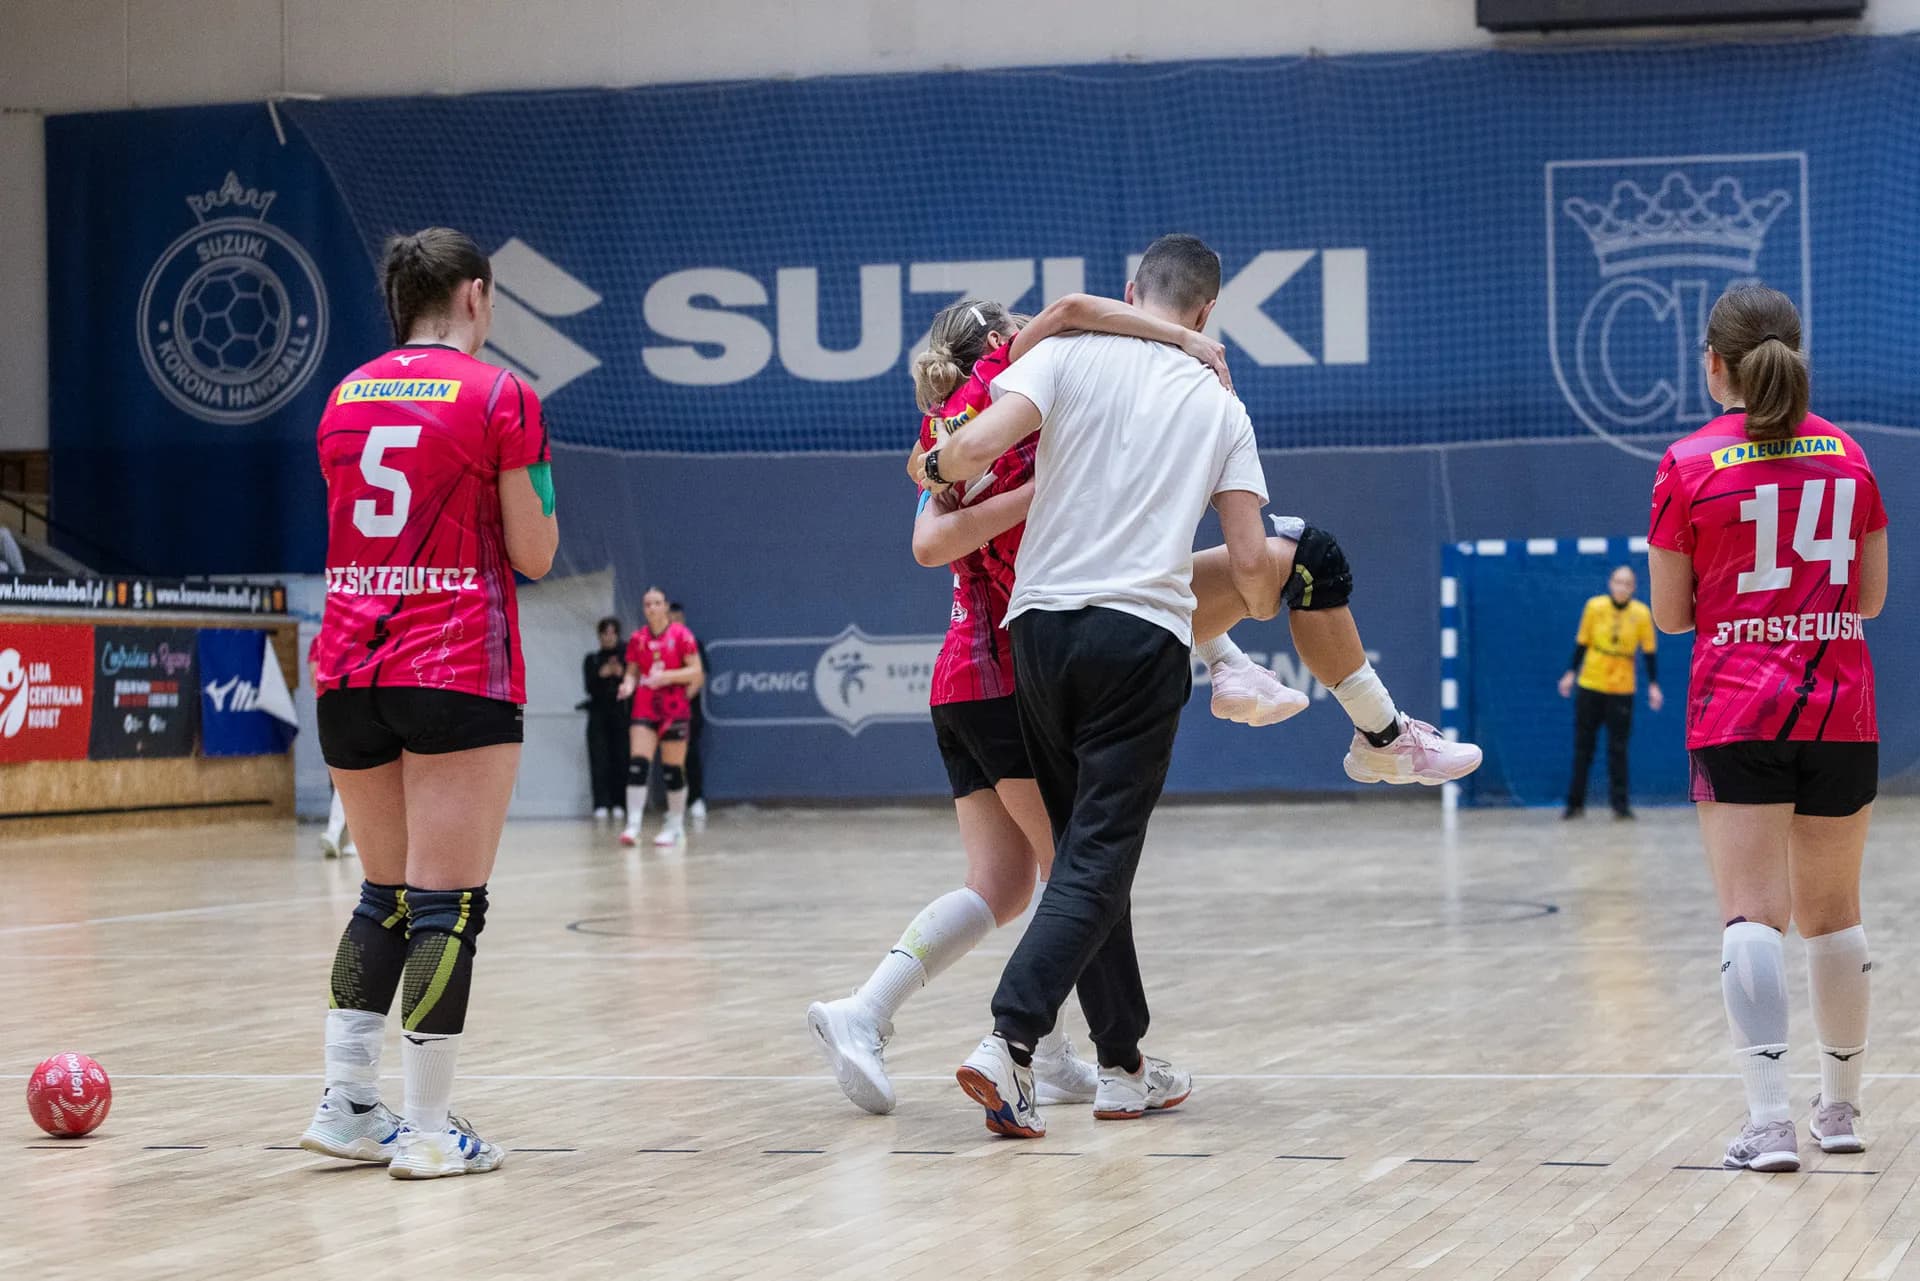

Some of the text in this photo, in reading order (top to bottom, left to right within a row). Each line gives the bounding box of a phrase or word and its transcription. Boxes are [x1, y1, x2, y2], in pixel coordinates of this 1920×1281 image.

[196, 233, 268, 262] SUZUKI
[156, 333, 310, 408] KORONA HANDBALL
[362, 381, 452, 399] LEWIATAN
[1748, 438, 1837, 459] LEWIATAN
[352, 425, 422, 538] 5
[1736, 477, 1857, 595] 14
[28, 662, 51, 683] LIGA
[736, 671, 810, 692] PGNiG
[28, 685, 83, 706] CENTRALNA
